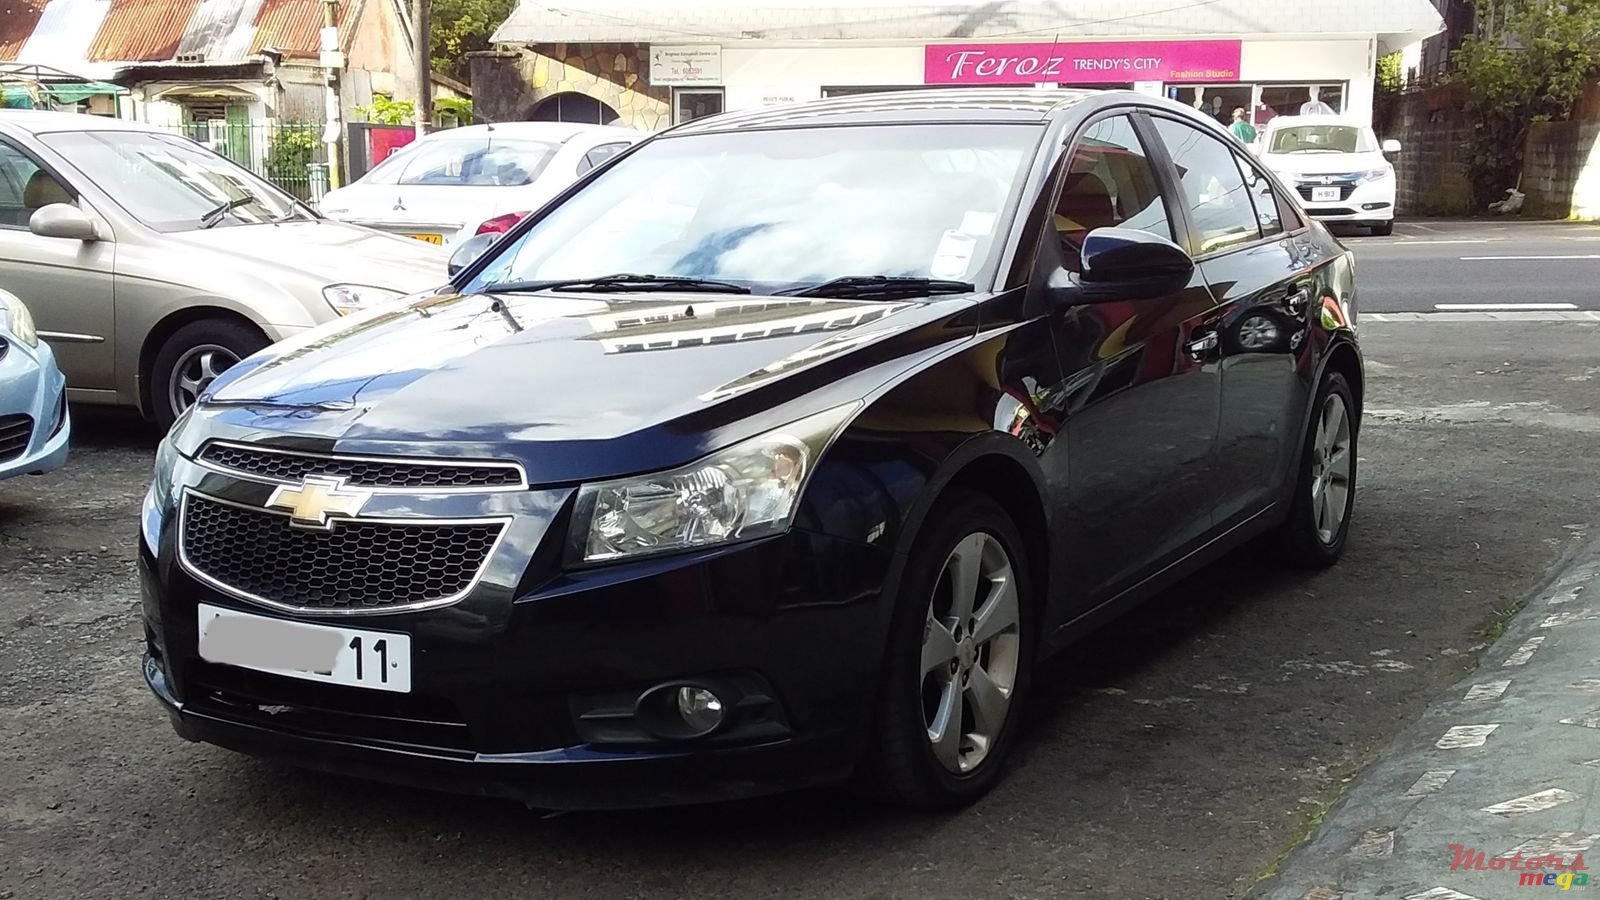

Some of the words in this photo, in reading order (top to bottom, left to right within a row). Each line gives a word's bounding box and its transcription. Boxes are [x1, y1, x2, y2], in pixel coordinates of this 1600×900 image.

[946, 50, 1063, 79] Feroz
[1072, 58, 1130, 71] TRENDY'S
[1133, 57, 1162, 70] CITY
[1170, 69, 1204, 78] Fashion
[1205, 69, 1235, 78] Studio
[349, 636, 388, 683] 11
